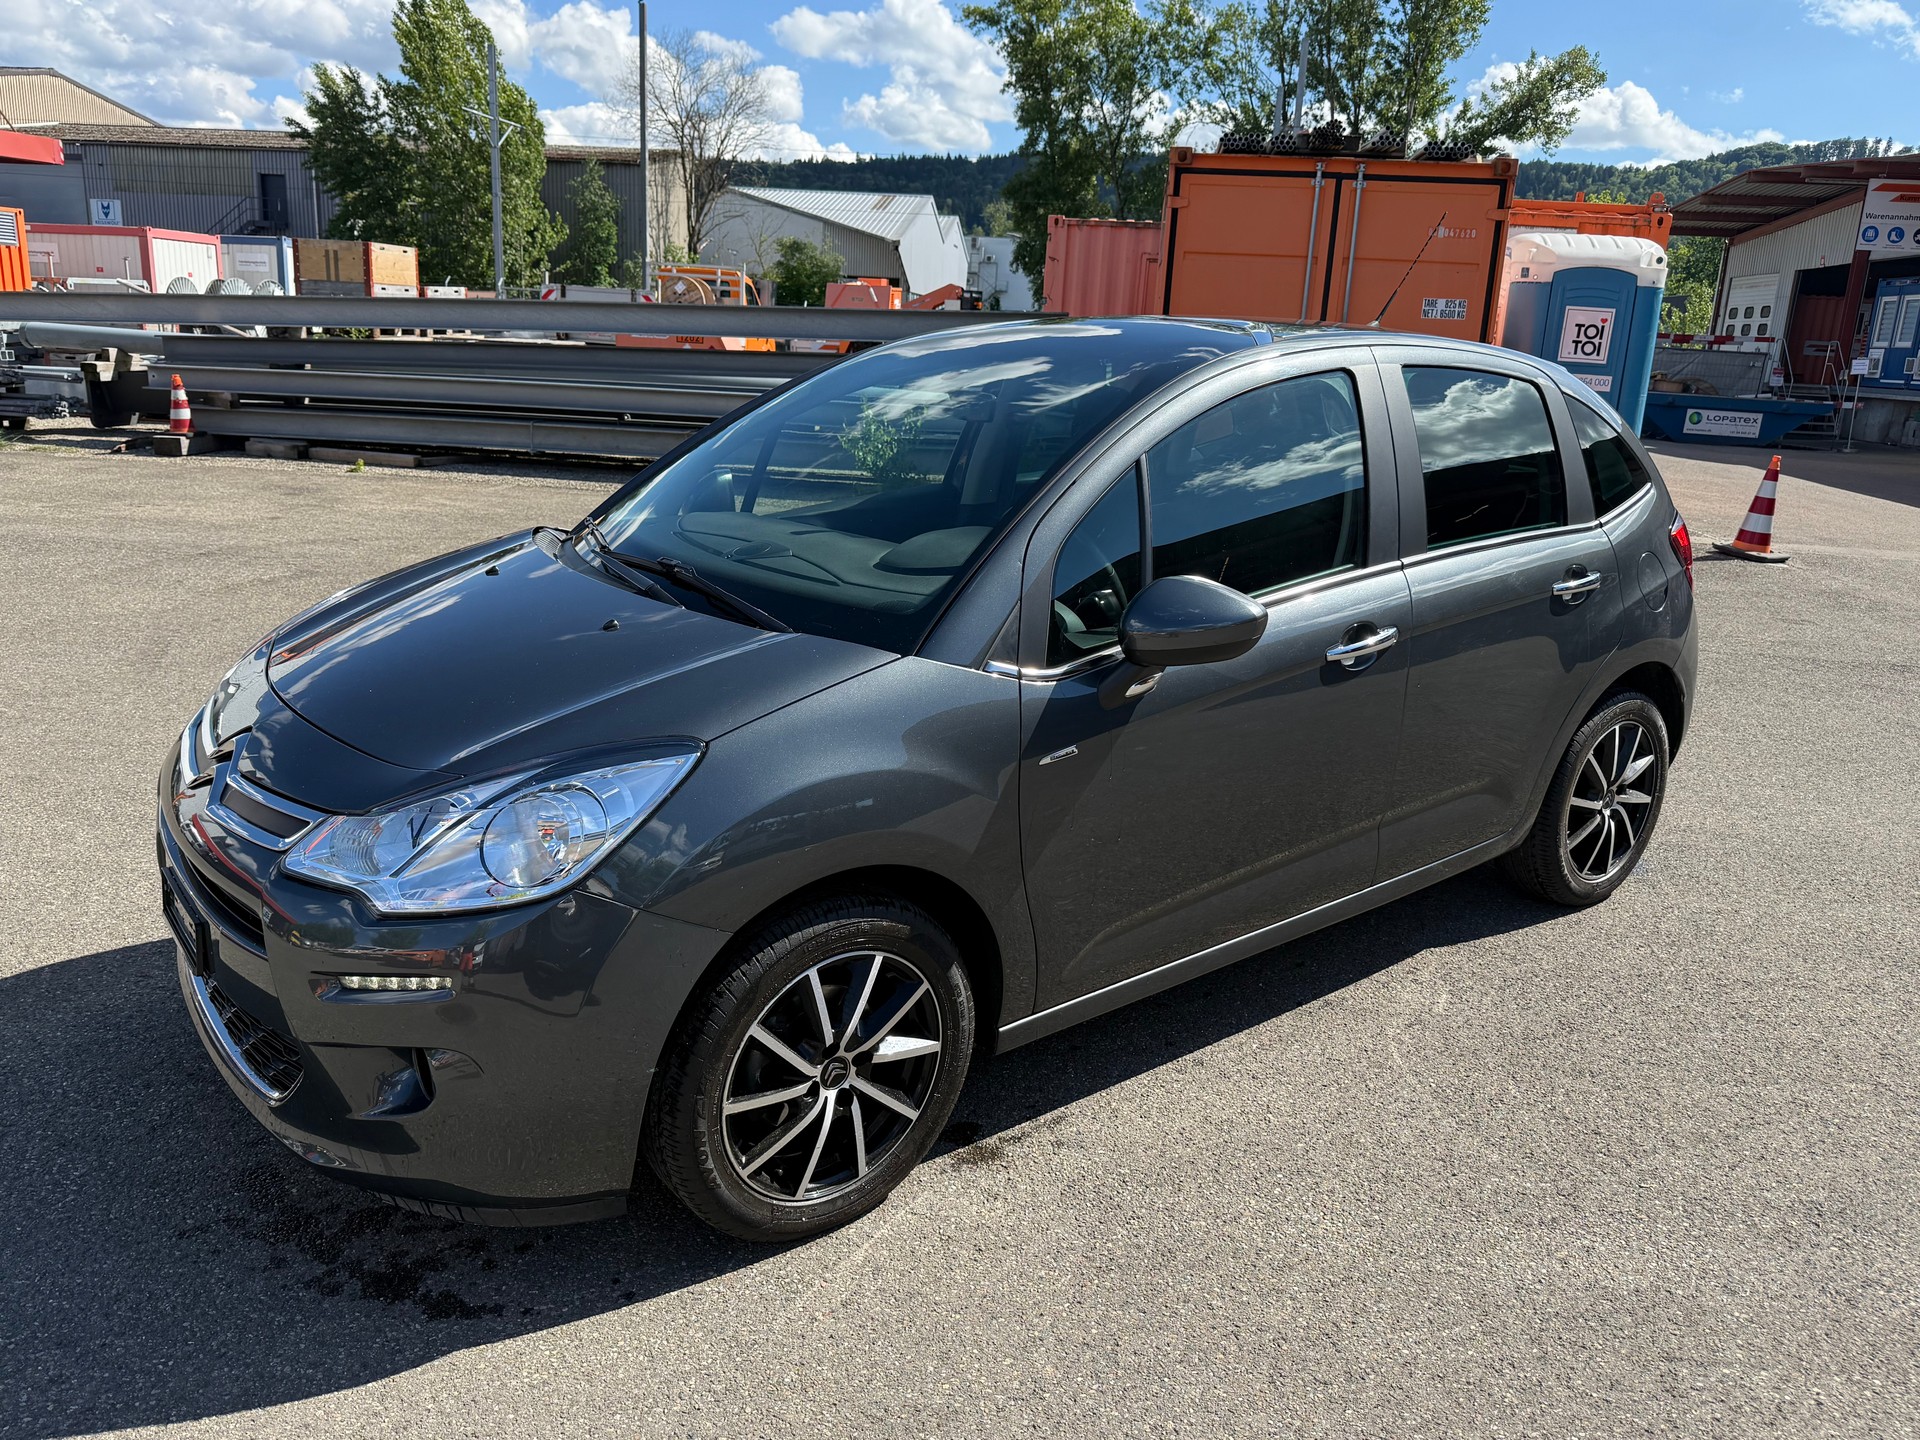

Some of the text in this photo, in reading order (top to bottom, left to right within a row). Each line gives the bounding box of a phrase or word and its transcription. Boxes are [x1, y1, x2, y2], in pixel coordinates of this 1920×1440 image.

[1424, 299, 1467, 310] TARE 825 KG
[1440, 309, 1456, 319] 6500
[1456, 310, 1466, 320] KG
[1575, 323, 1605, 340] TOI
[1572, 340, 1602, 357] TOI
[1594, 378, 1610, 387] 000
